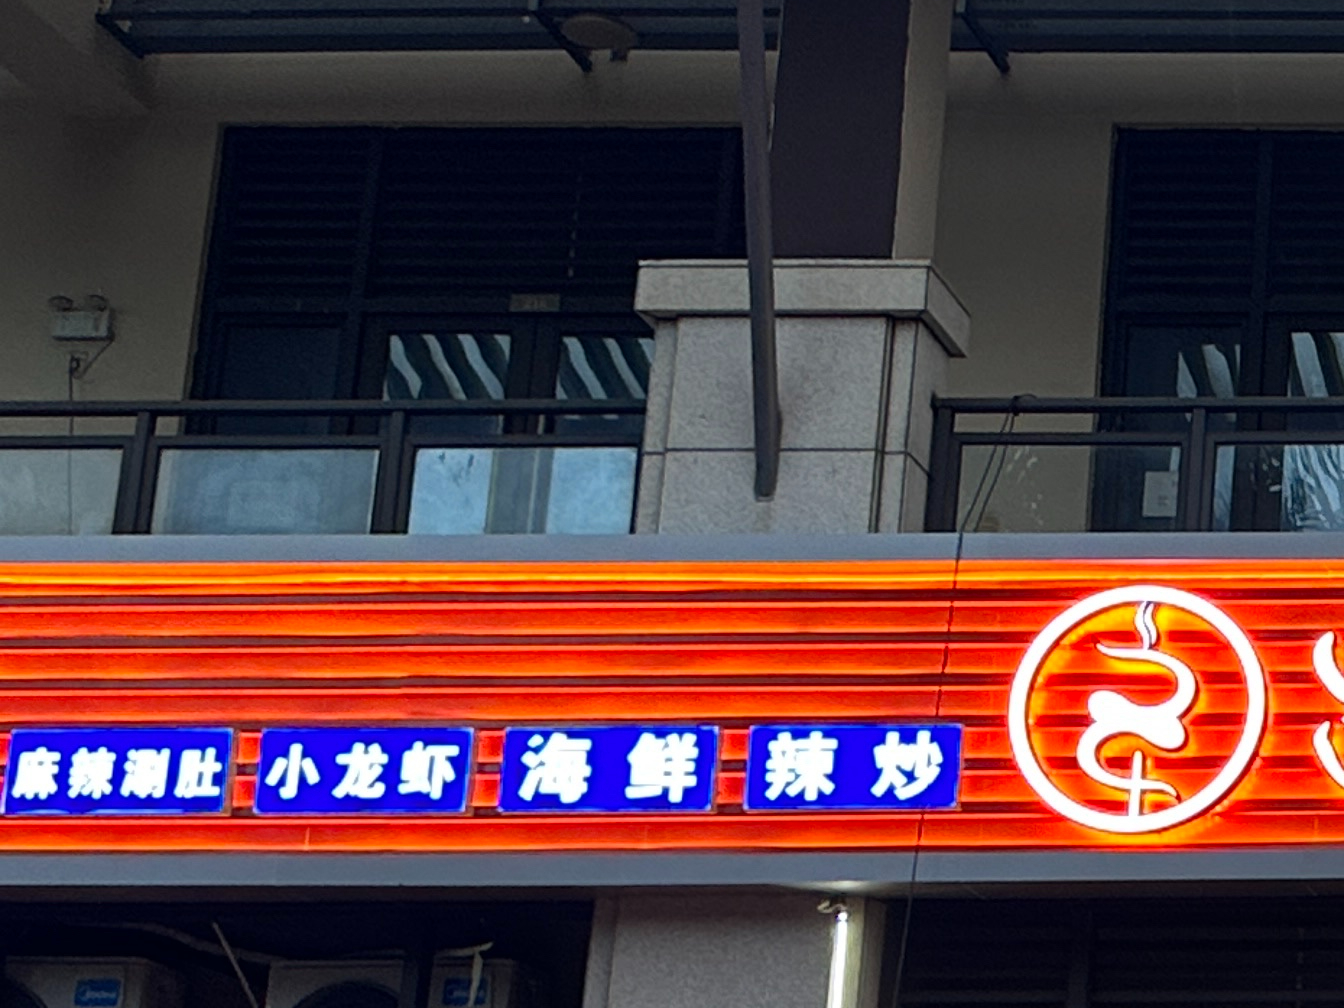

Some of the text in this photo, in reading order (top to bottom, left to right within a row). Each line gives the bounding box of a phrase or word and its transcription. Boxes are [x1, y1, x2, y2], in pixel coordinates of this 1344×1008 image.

[10, 744, 223, 802] 麻辣涮肚
[264, 740, 461, 801] 小龙虾
[517, 731, 700, 805] 海鲜
[764, 730, 944, 802] 辣炒
